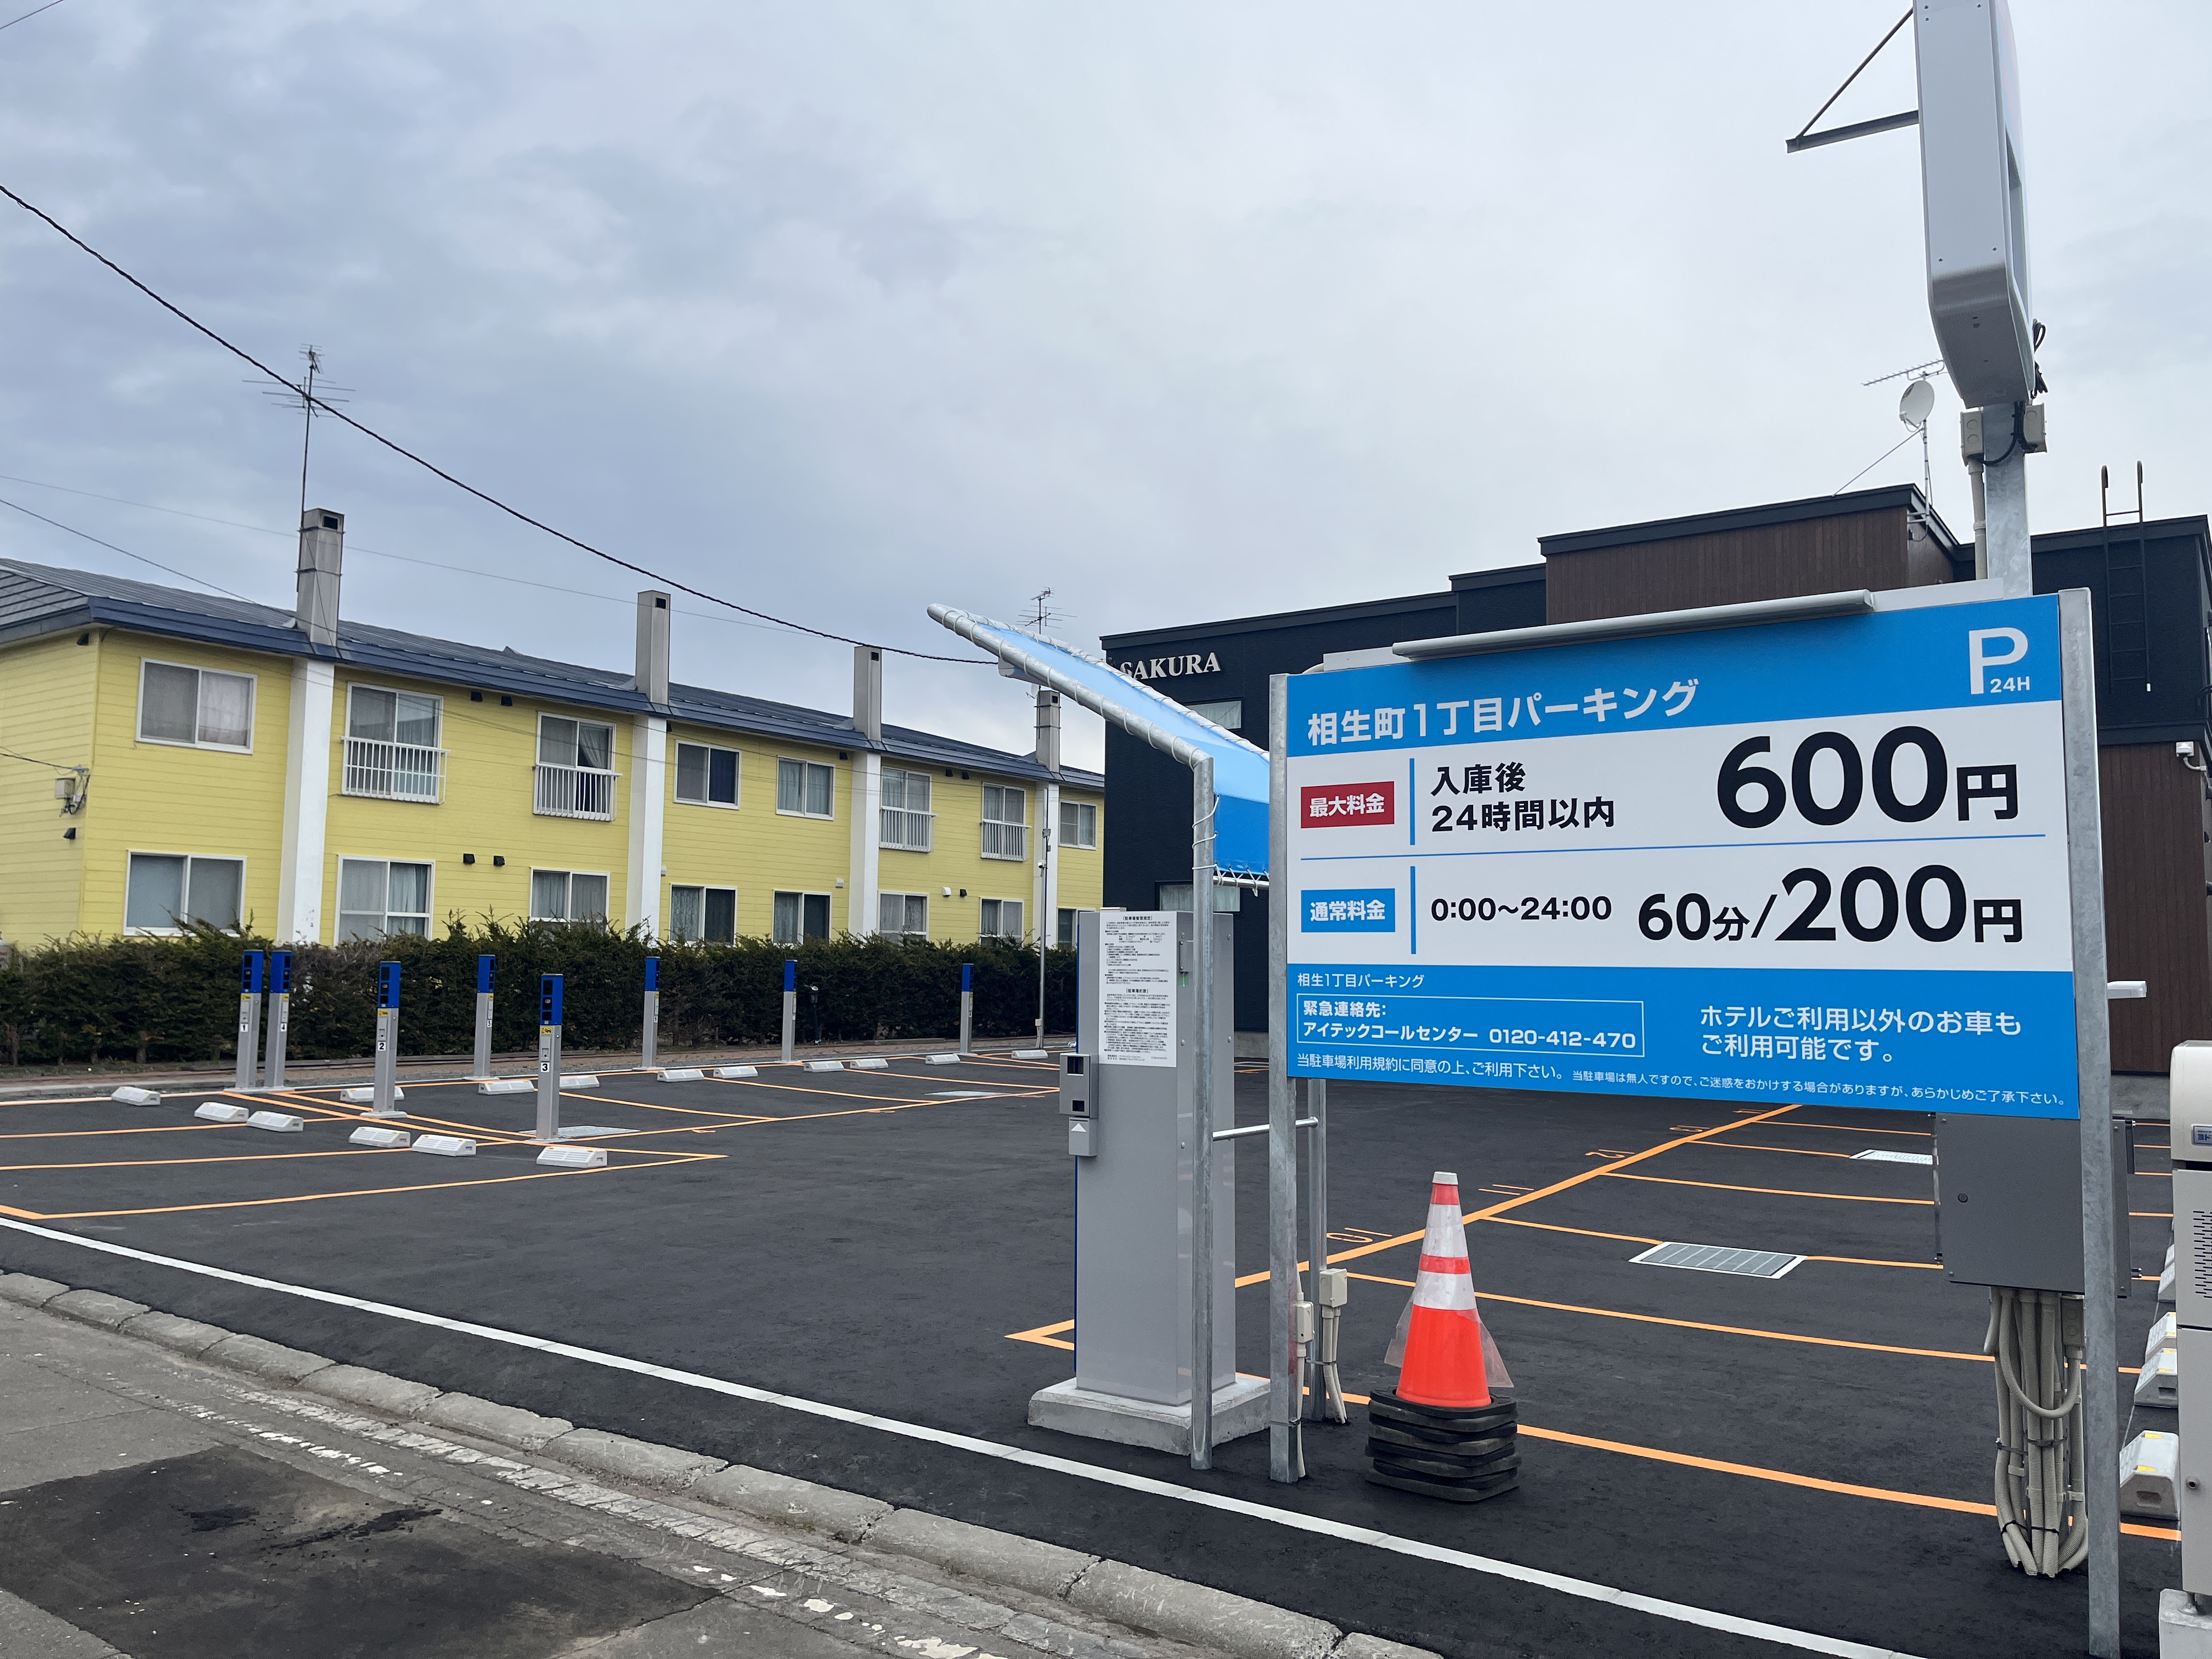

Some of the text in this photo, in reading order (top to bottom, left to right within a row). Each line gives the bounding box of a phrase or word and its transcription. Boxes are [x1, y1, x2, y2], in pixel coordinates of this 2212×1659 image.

[1120, 652, 1221, 680] SAKURA
[1969, 627, 2029, 695] P
[1990, 676, 2030, 693] 24H
[1308, 679, 1699, 746] 相生町1丁目パーキング
[1431, 762, 1526, 796] 入庫後
[1718, 726, 2018, 828] 600円
[1310, 793, 1385, 817] 最大料金
[1431, 796, 1614, 832] 24時間以内
[1310, 899, 1385, 922] 通常料金
[1638, 865, 2023, 943] 60分/200円
[1297, 973, 1425, 988] 相生1丁目パーキング
[1303, 1000, 1386, 1018] 緊急連絡先:
[1701, 1006, 2022, 1036] ホテルご利用以外のお車も
[1303, 1022, 1636, 1048] アイテックコールセンター 0120-412-470
[1702, 1034, 1893, 1062] ご利用可能です。
[542, 1063, 548, 1071] 3
[1296, 1053, 1562, 1080] 当駐車場利用規約に同意の上、ご利用下さい。
